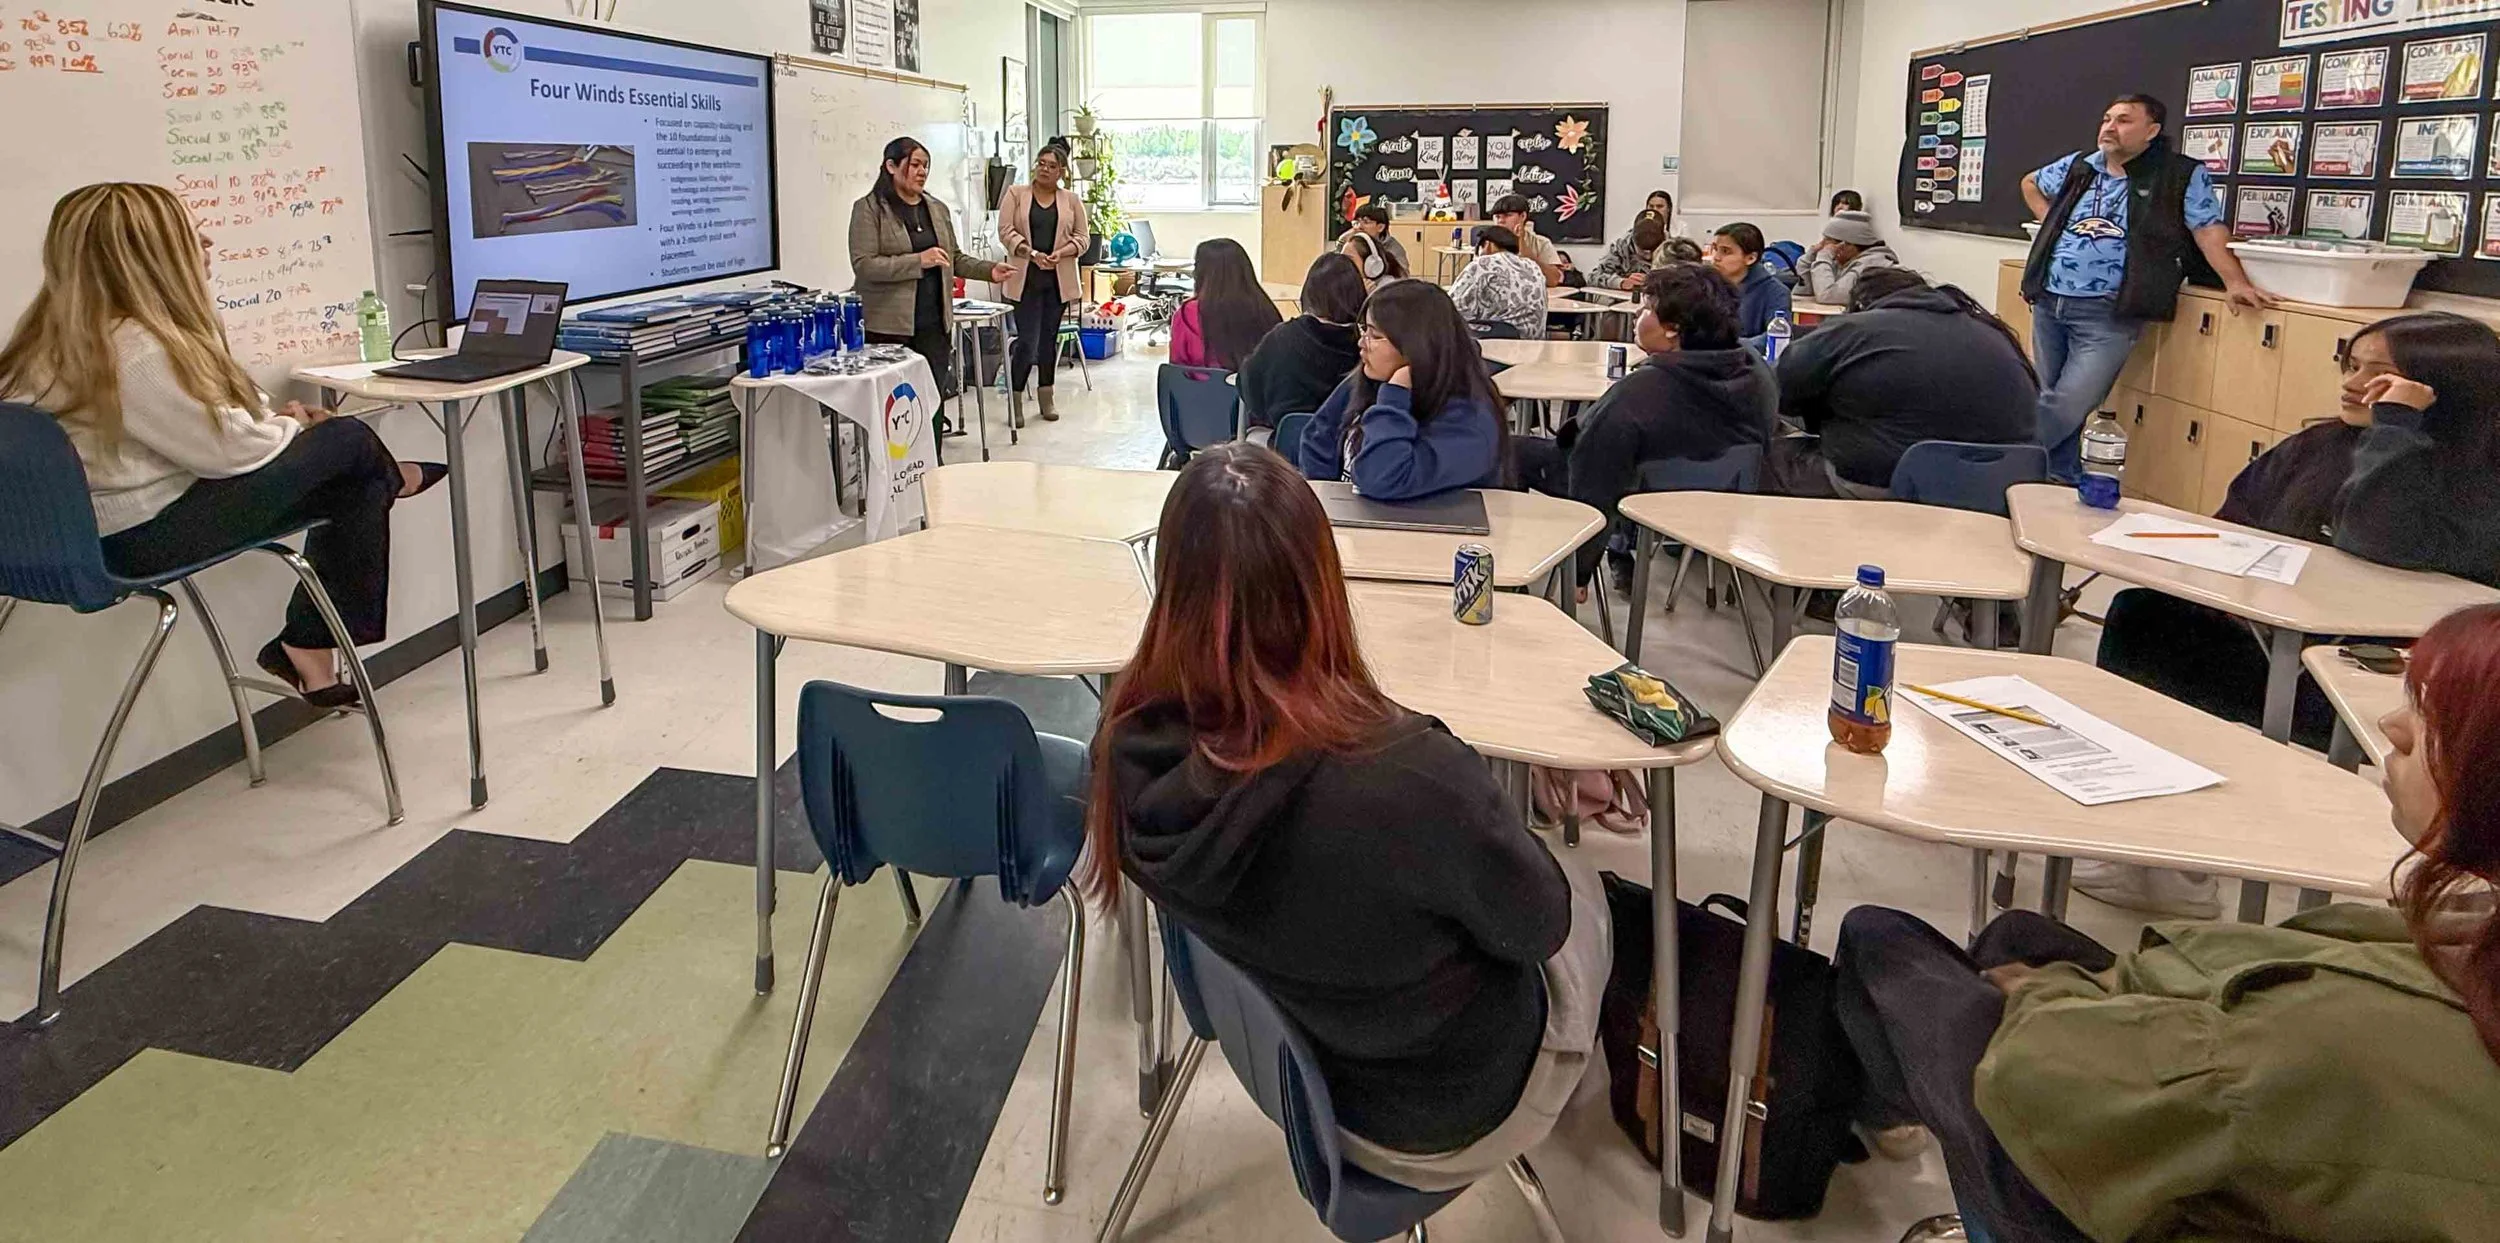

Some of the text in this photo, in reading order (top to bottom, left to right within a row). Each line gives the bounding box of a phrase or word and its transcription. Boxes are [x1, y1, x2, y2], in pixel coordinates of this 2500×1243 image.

[2287, 0, 2394, 30] TESTING
[208, 25, 240, 36] 14-17
[494, 45, 512, 56] YTC
[2410, 40, 2480, 58] CONRAST
[2324, 54, 2382, 69] COMARE
[530, 78, 722, 112] Four Winds Essential Skills
[656, 118, 682, 128] Focused
[167, 128, 210, 144] Social
[656, 132, 667, 140] the
[670, 132, 677, 140] 10
[2188, 130, 2228, 140] EVAUATE
[2250, 128, 2294, 138] EXPAIN
[2318, 126, 2373, 137] FORULAT
[1424, 141, 1436, 149] BE
[1488, 142, 1512, 150] YOU
[1419, 150, 1442, 162] Kind
[1454, 151, 1476, 162] Story
[1488, 150, 1511, 160] Matter
[658, 161, 692, 170] succeeding
[174, 174, 218, 191] Social
[230, 176, 240, 188] 10
[1458, 188, 1472, 202] Up
[2242, 191, 2288, 202] PERUADE
[229, 196, 245, 206] 30
[2316, 196, 2364, 208] PREDICT
[233, 214, 252, 225] 20
[660, 224, 674, 232] Four
[676, 222, 696, 231] Winds
[660, 238, 674, 246] with
[662, 267, 689, 276] Students
[691, 264, 706, 272] must
[708, 262, 715, 270] be
[216, 294, 260, 310] Social
[266, 289, 282, 304] 20
